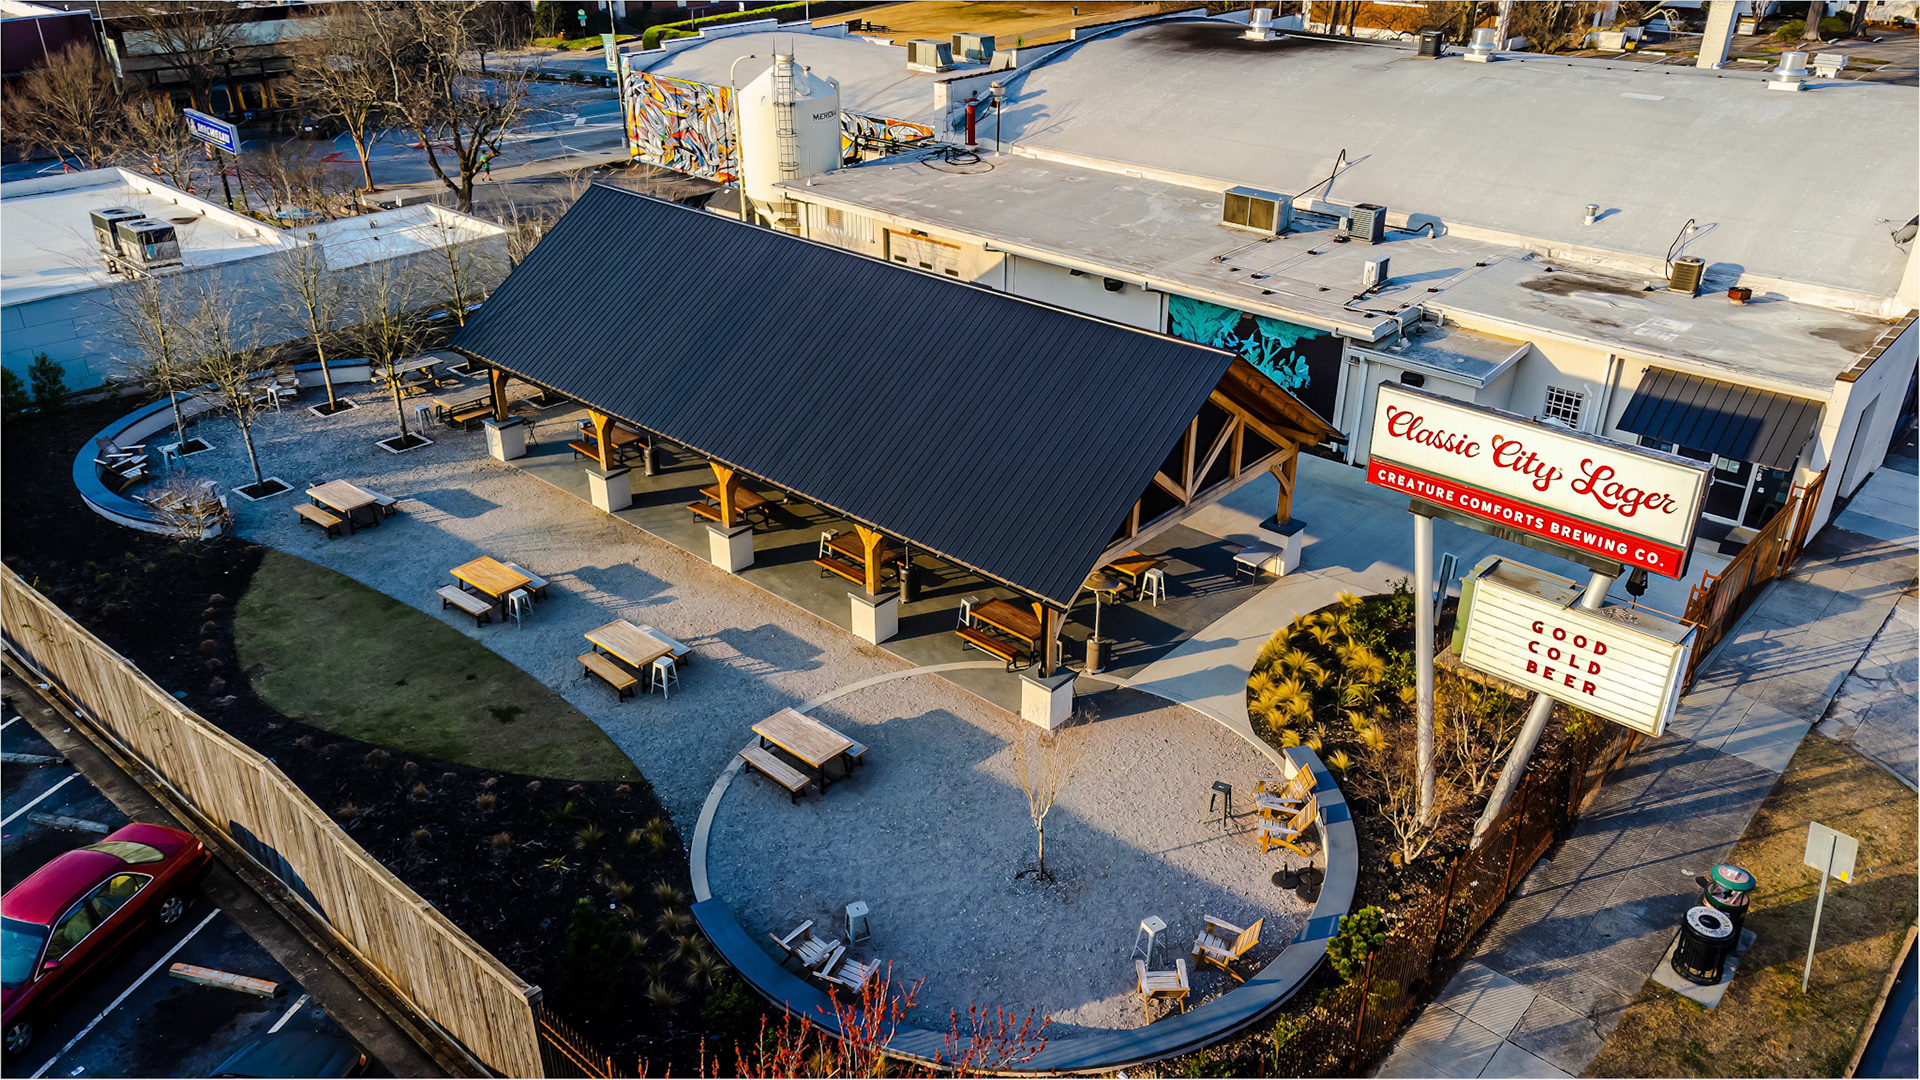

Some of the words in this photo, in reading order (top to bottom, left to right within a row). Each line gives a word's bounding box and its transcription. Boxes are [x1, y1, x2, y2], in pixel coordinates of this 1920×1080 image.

[1386, 405, 1480, 458] Classic
[1491, 434, 1563, 492] City
[1570, 458, 1678, 518] Lager
[1377, 469, 1455, 502] CREATURE
[1459, 494, 1545, 530] COMFORTS
[1549, 522, 1629, 555] BREWING
[1634, 548, 1665, 567] CO.
[1532, 620, 1608, 656] GOOD
[1527, 640, 1602, 677] COLD
[1526, 659, 1597, 696] BEER
